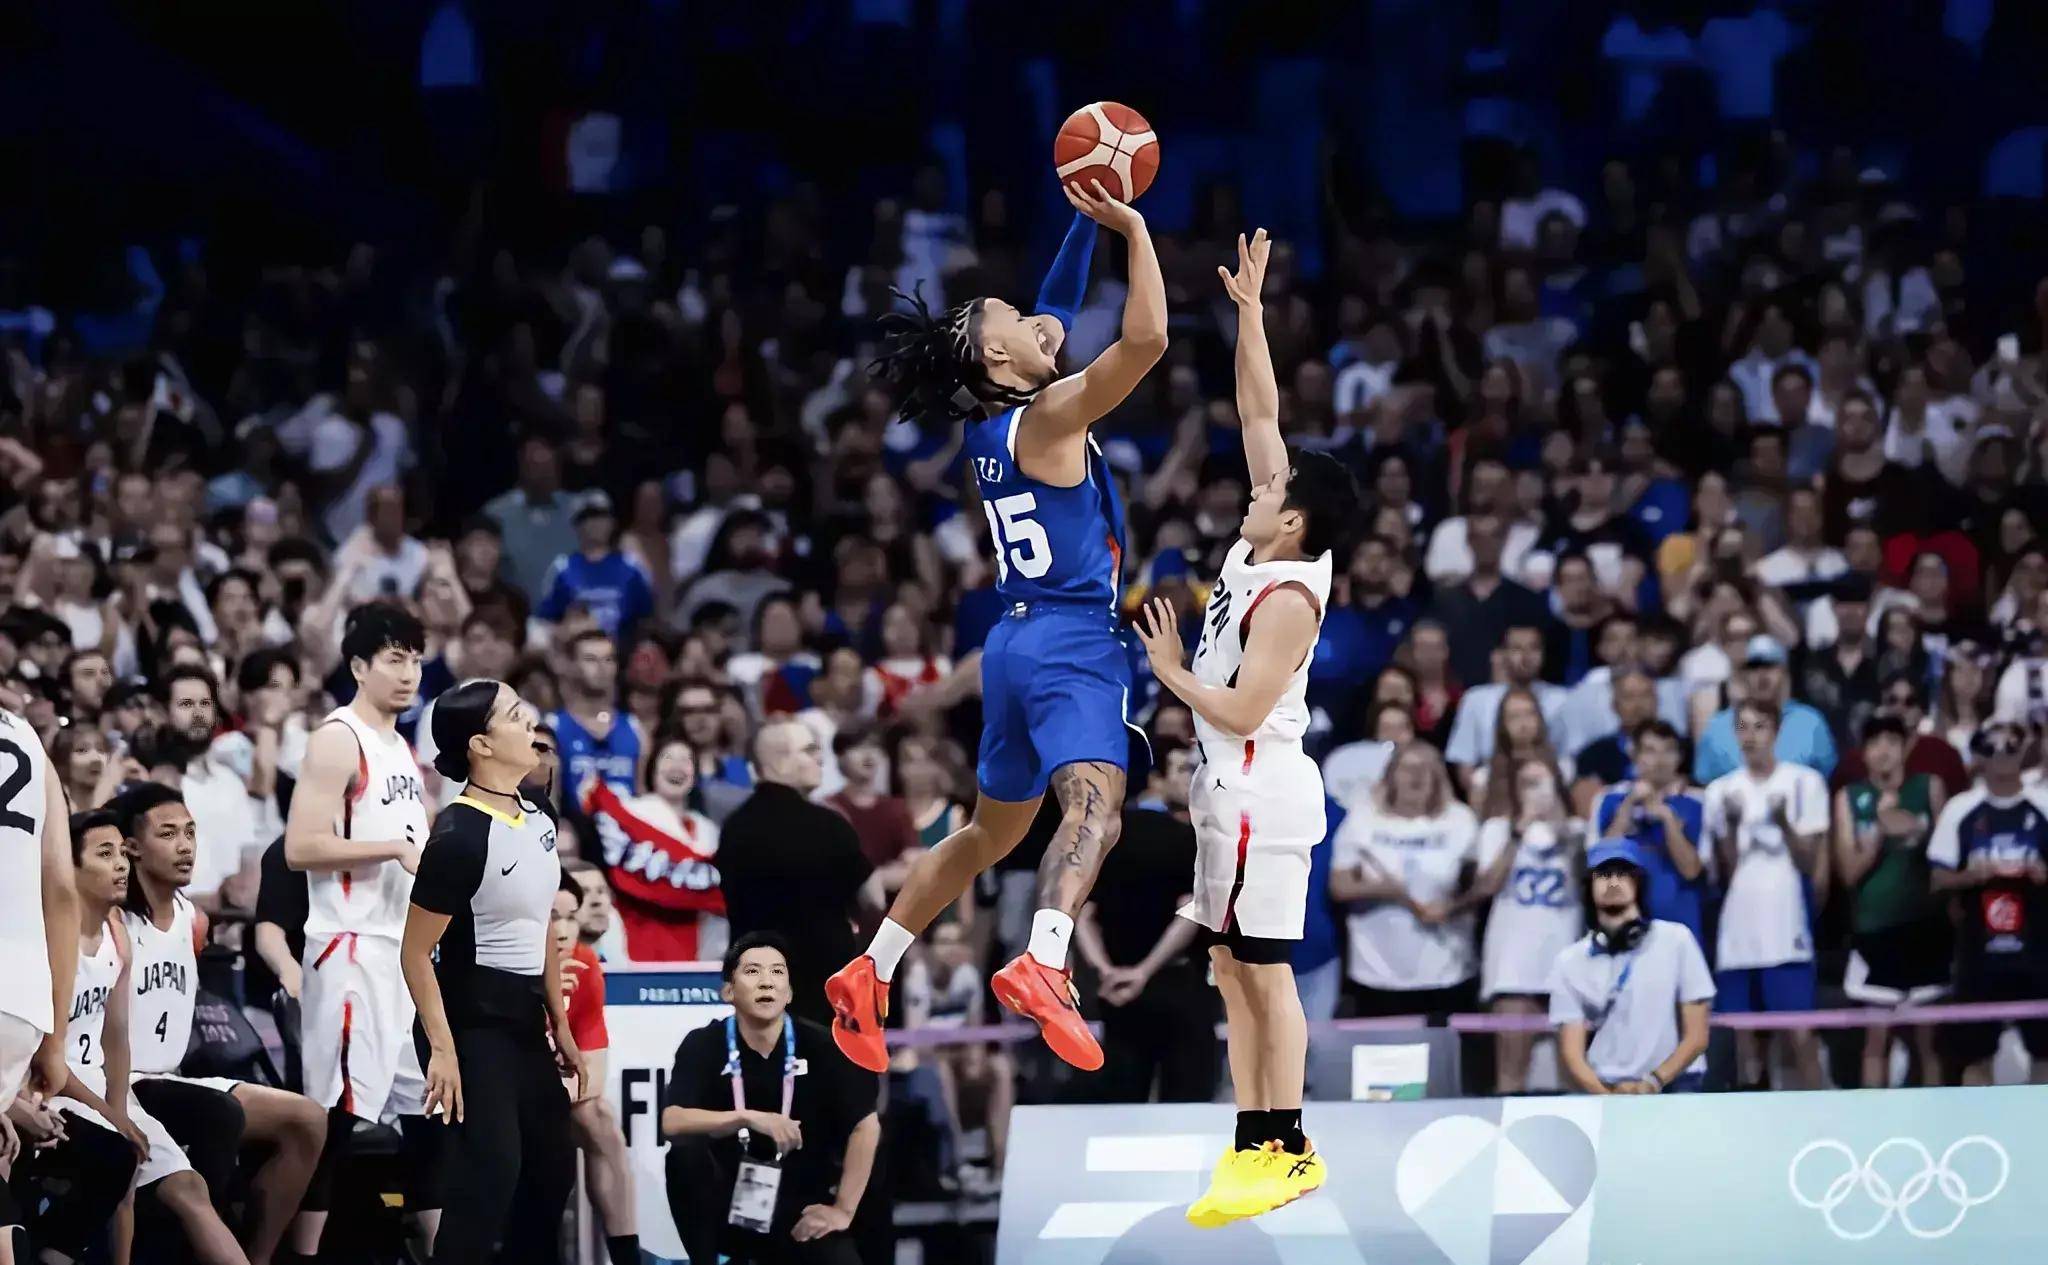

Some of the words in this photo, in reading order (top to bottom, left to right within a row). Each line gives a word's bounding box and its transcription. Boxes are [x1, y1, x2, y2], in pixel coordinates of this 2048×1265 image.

[983, 492, 1053, 585] 15
[381, 775, 420, 806] JAPA
[1517, 866, 1565, 907] 32
[137, 961, 187, 996] JAPAN
[68, 986, 112, 1023] JAPA
[155, 1011, 169, 1043] 4
[79, 1033, 91, 1065] 2
[621, 1068, 666, 1148] FI
